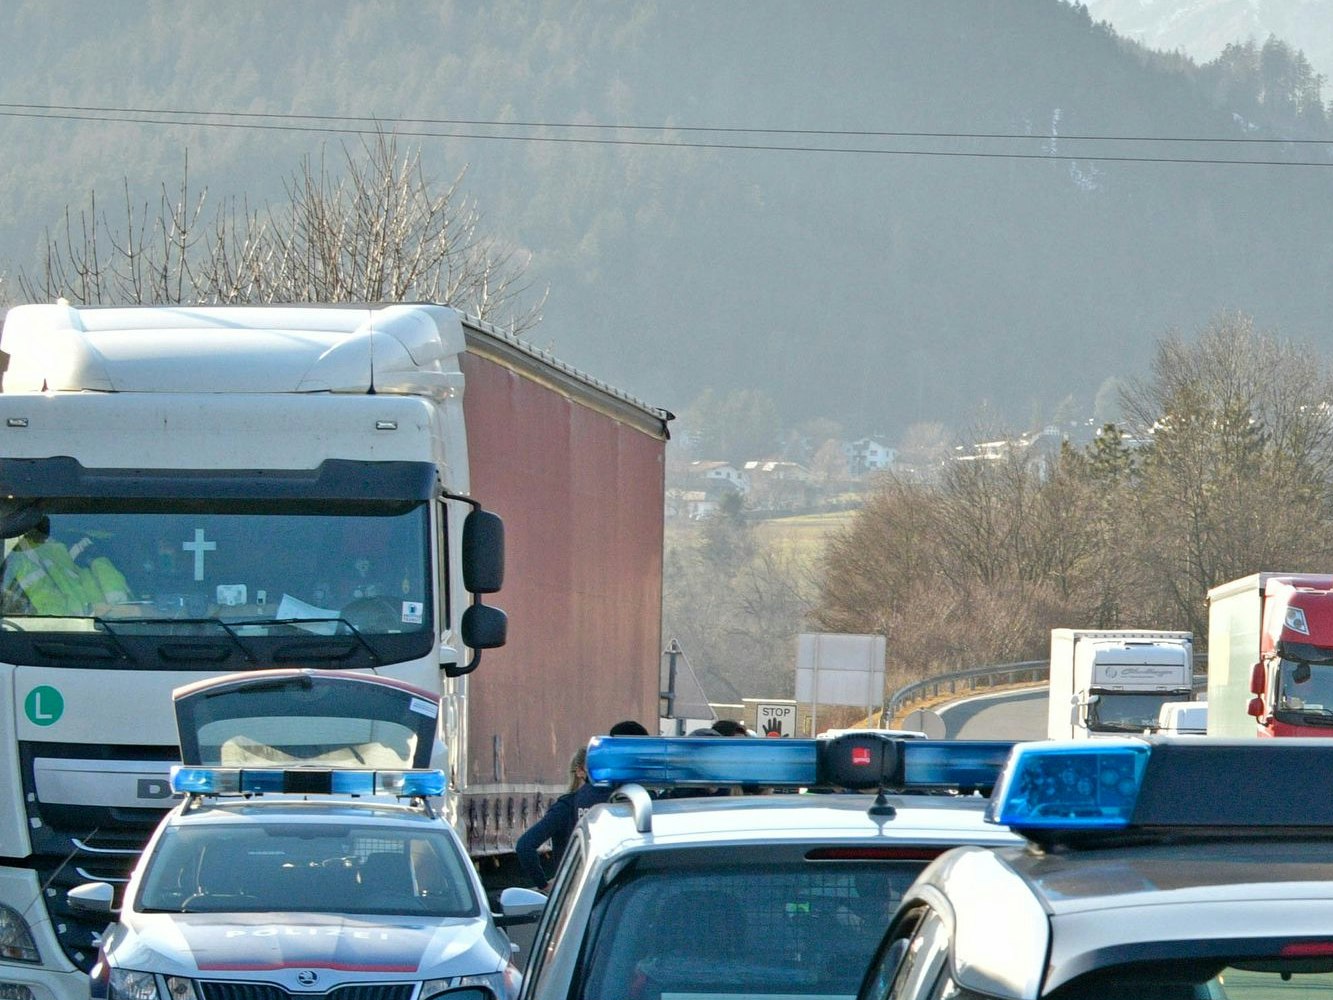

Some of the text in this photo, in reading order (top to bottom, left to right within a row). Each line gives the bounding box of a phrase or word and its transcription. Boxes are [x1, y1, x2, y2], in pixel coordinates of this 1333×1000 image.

[36, 692, 53, 719] L
[762, 707, 791, 718] STOP
[225, 926, 388, 940] POLIZEI
